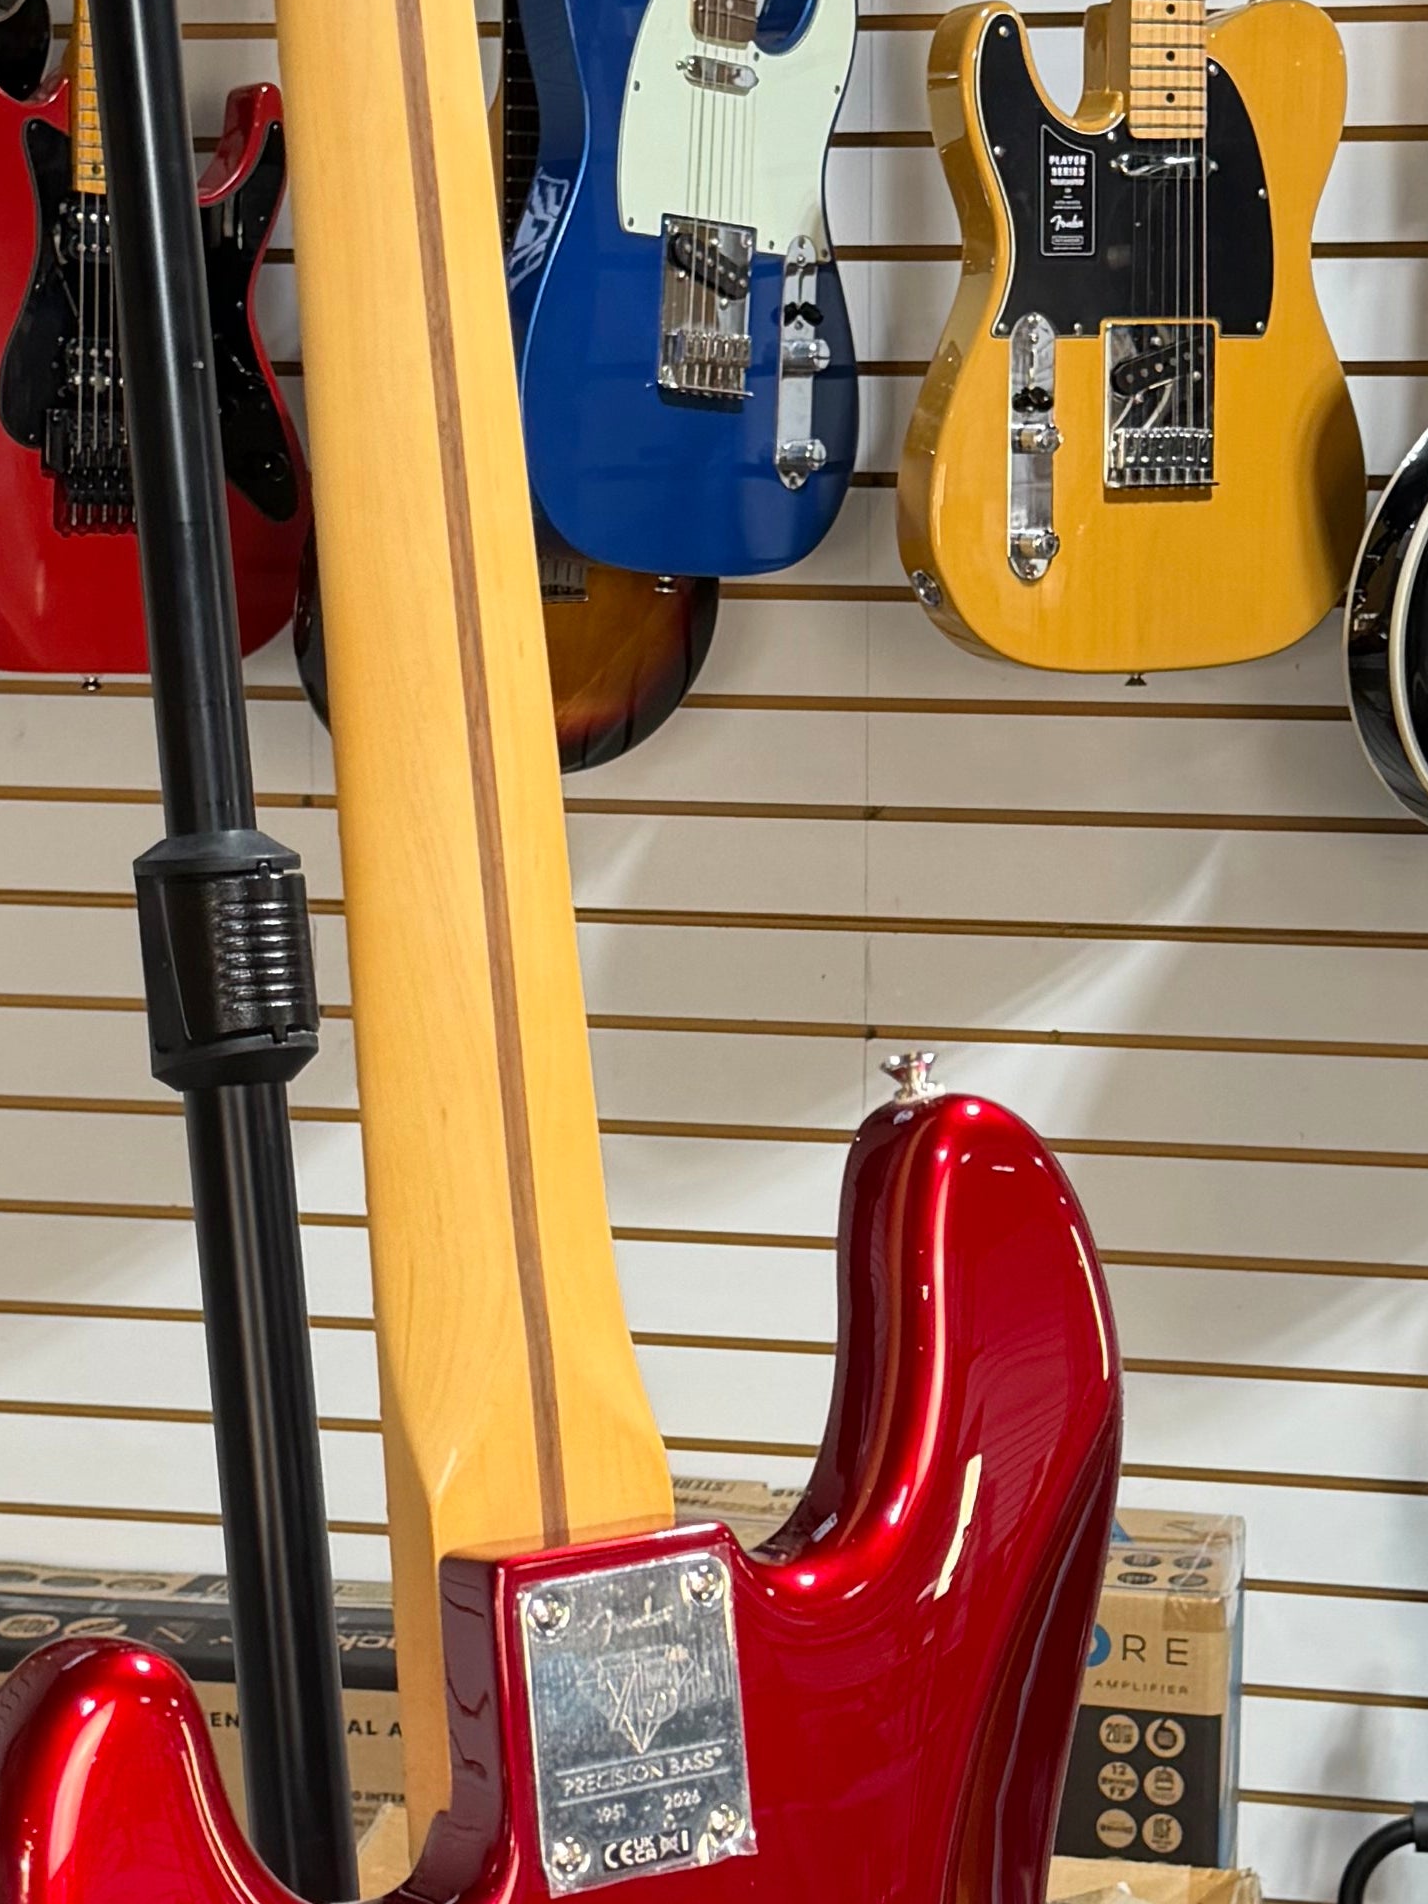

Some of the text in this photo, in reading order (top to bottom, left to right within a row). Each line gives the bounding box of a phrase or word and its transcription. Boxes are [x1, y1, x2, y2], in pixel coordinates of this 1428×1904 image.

[1049, 155, 1087, 166] PLAYER
[1092, 1678, 1190, 1696] AMPLIFIER
[562, 1756, 664, 1798] PRECISION
